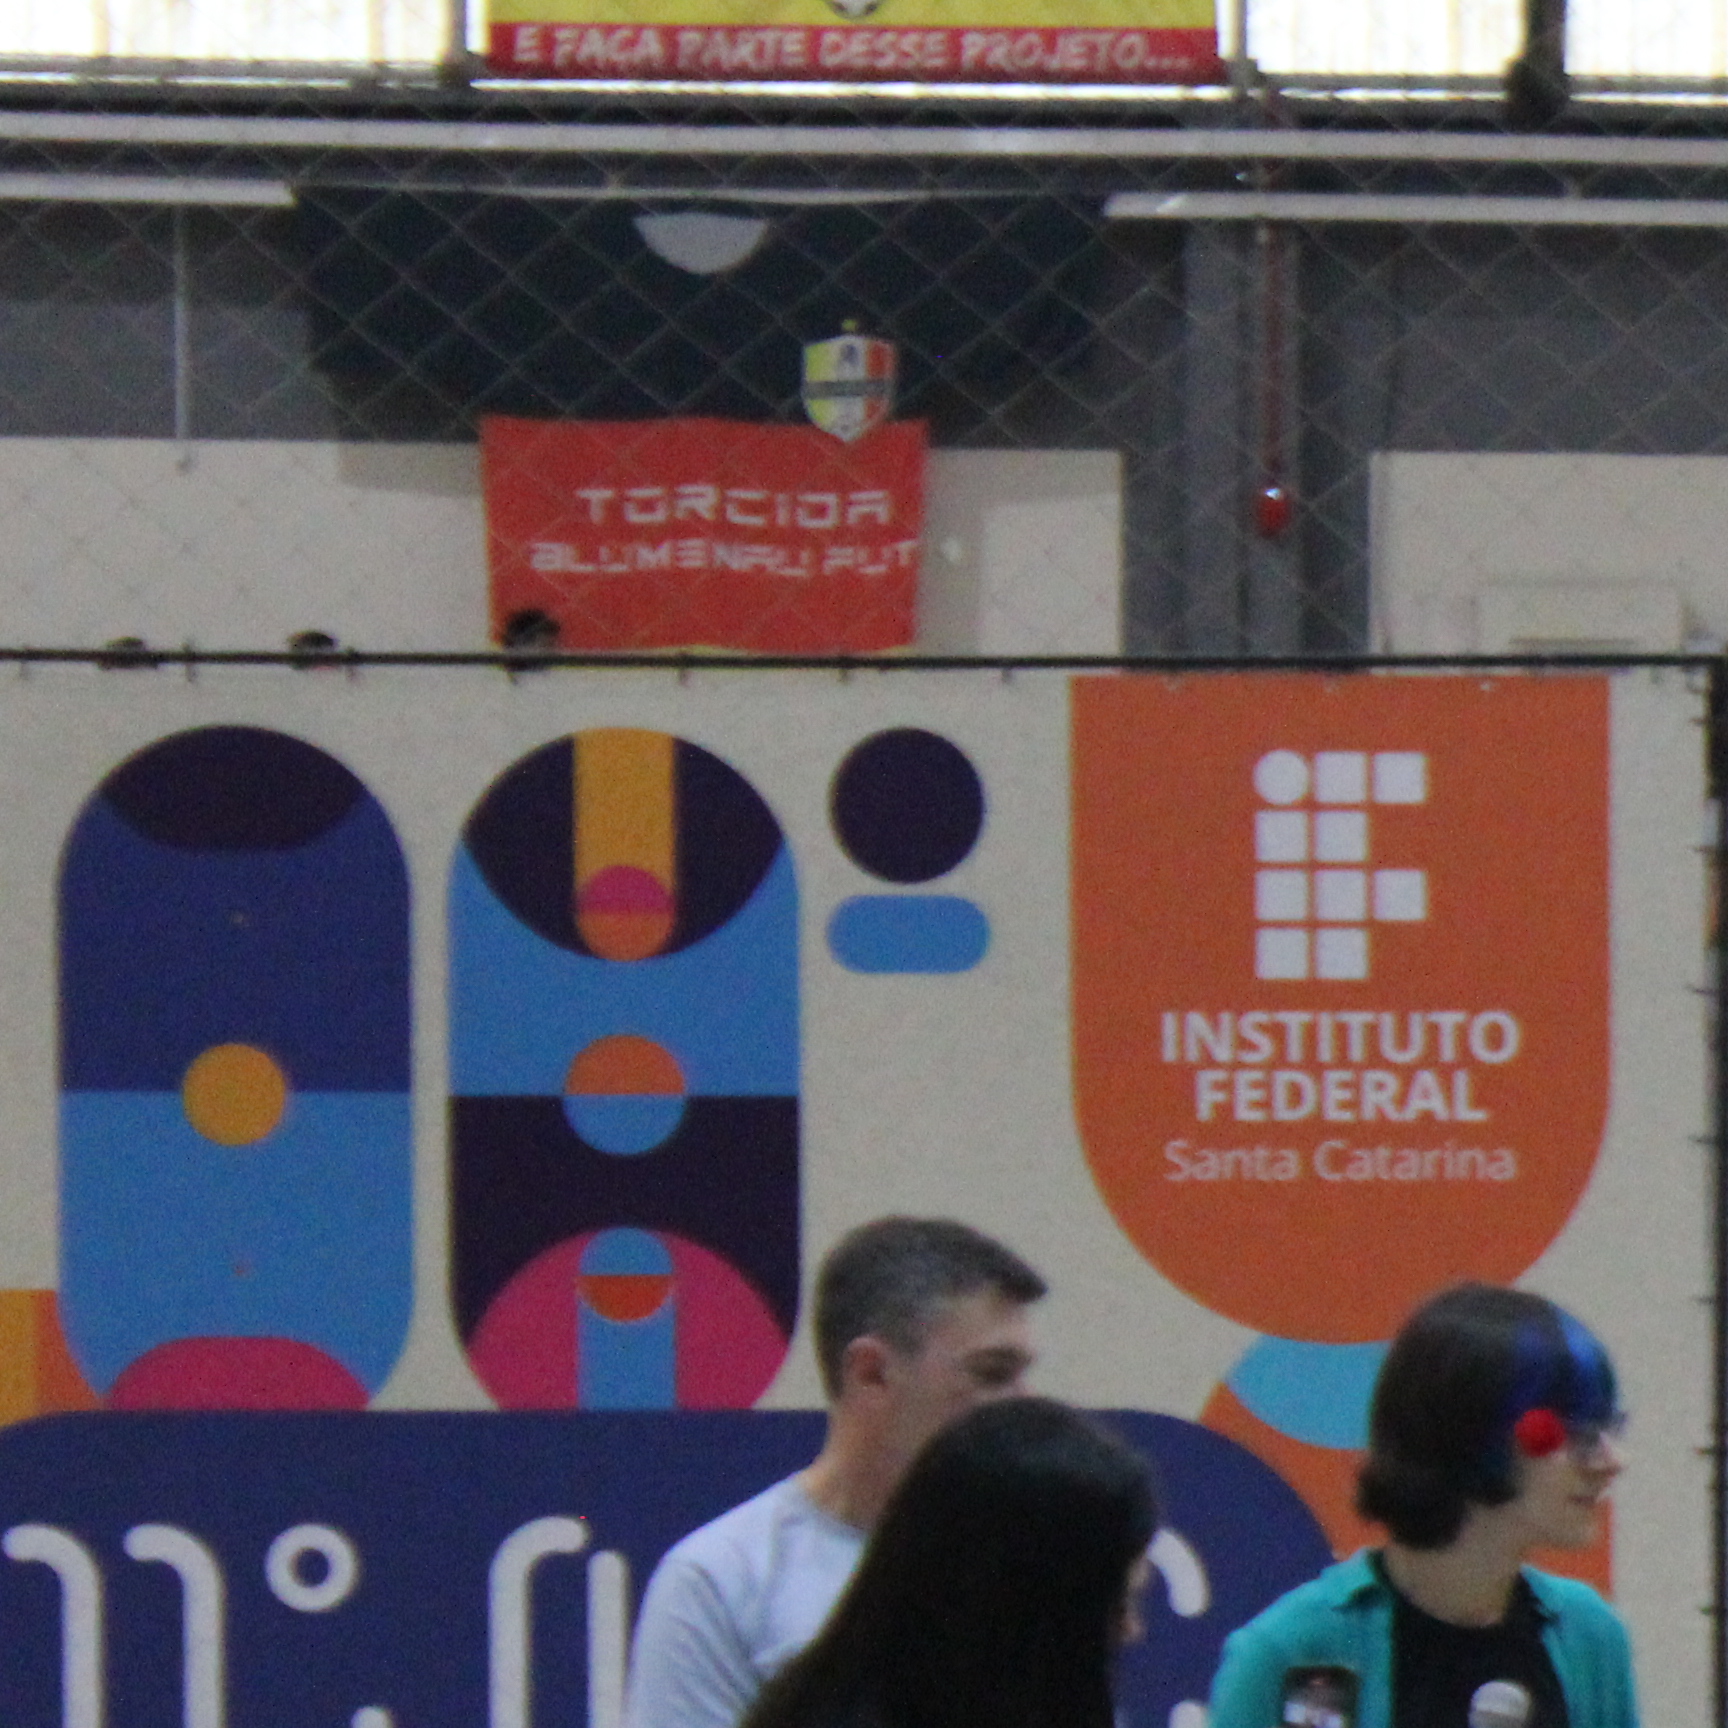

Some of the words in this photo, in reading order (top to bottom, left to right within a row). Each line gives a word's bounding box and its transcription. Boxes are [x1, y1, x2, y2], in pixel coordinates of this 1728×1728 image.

[512, 25, 541, 63] E
[675, 28, 805, 71] PARTE
[818, 31, 948, 69] DESSE
[574, 483, 889, 528] TORCIDA
[1160, 1010, 1522, 1064] INSTITUTO
[1195, 1069, 1488, 1122] FEDERAL
[1163, 1138, 1298, 1182] Santa
[1312, 1139, 1519, 1182] Catarina
